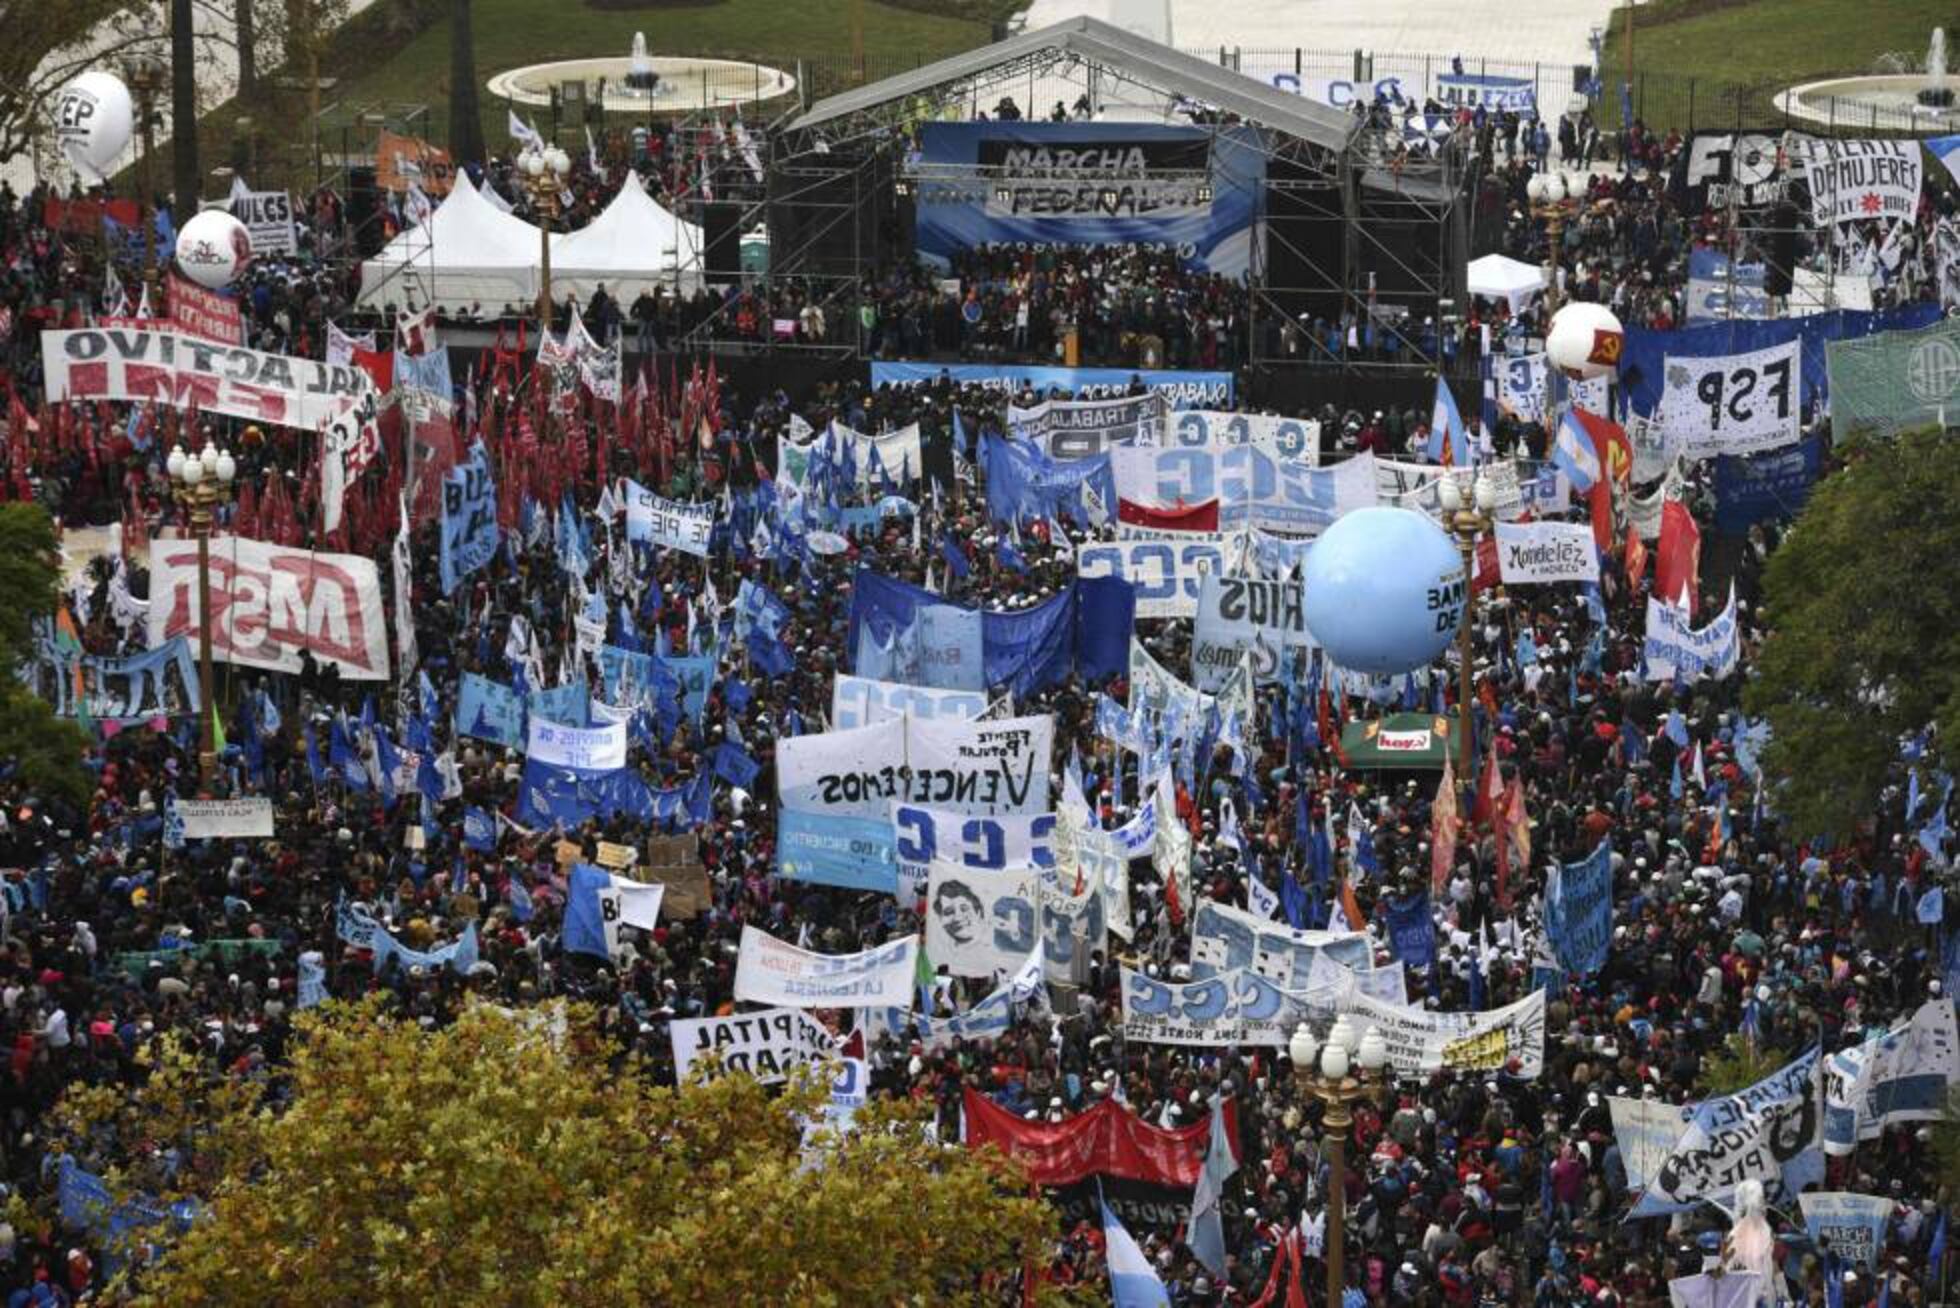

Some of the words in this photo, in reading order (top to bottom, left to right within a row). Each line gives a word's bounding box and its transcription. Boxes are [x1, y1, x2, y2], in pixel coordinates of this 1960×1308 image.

[1003, 147, 1147, 178] MARCHA
[1807, 139, 1906, 158] FRENTE
[1840, 157, 1917, 192] MUJERES
[1011, 183, 1162, 216] FEDERAL
[1436, 607, 1459, 633] DE
